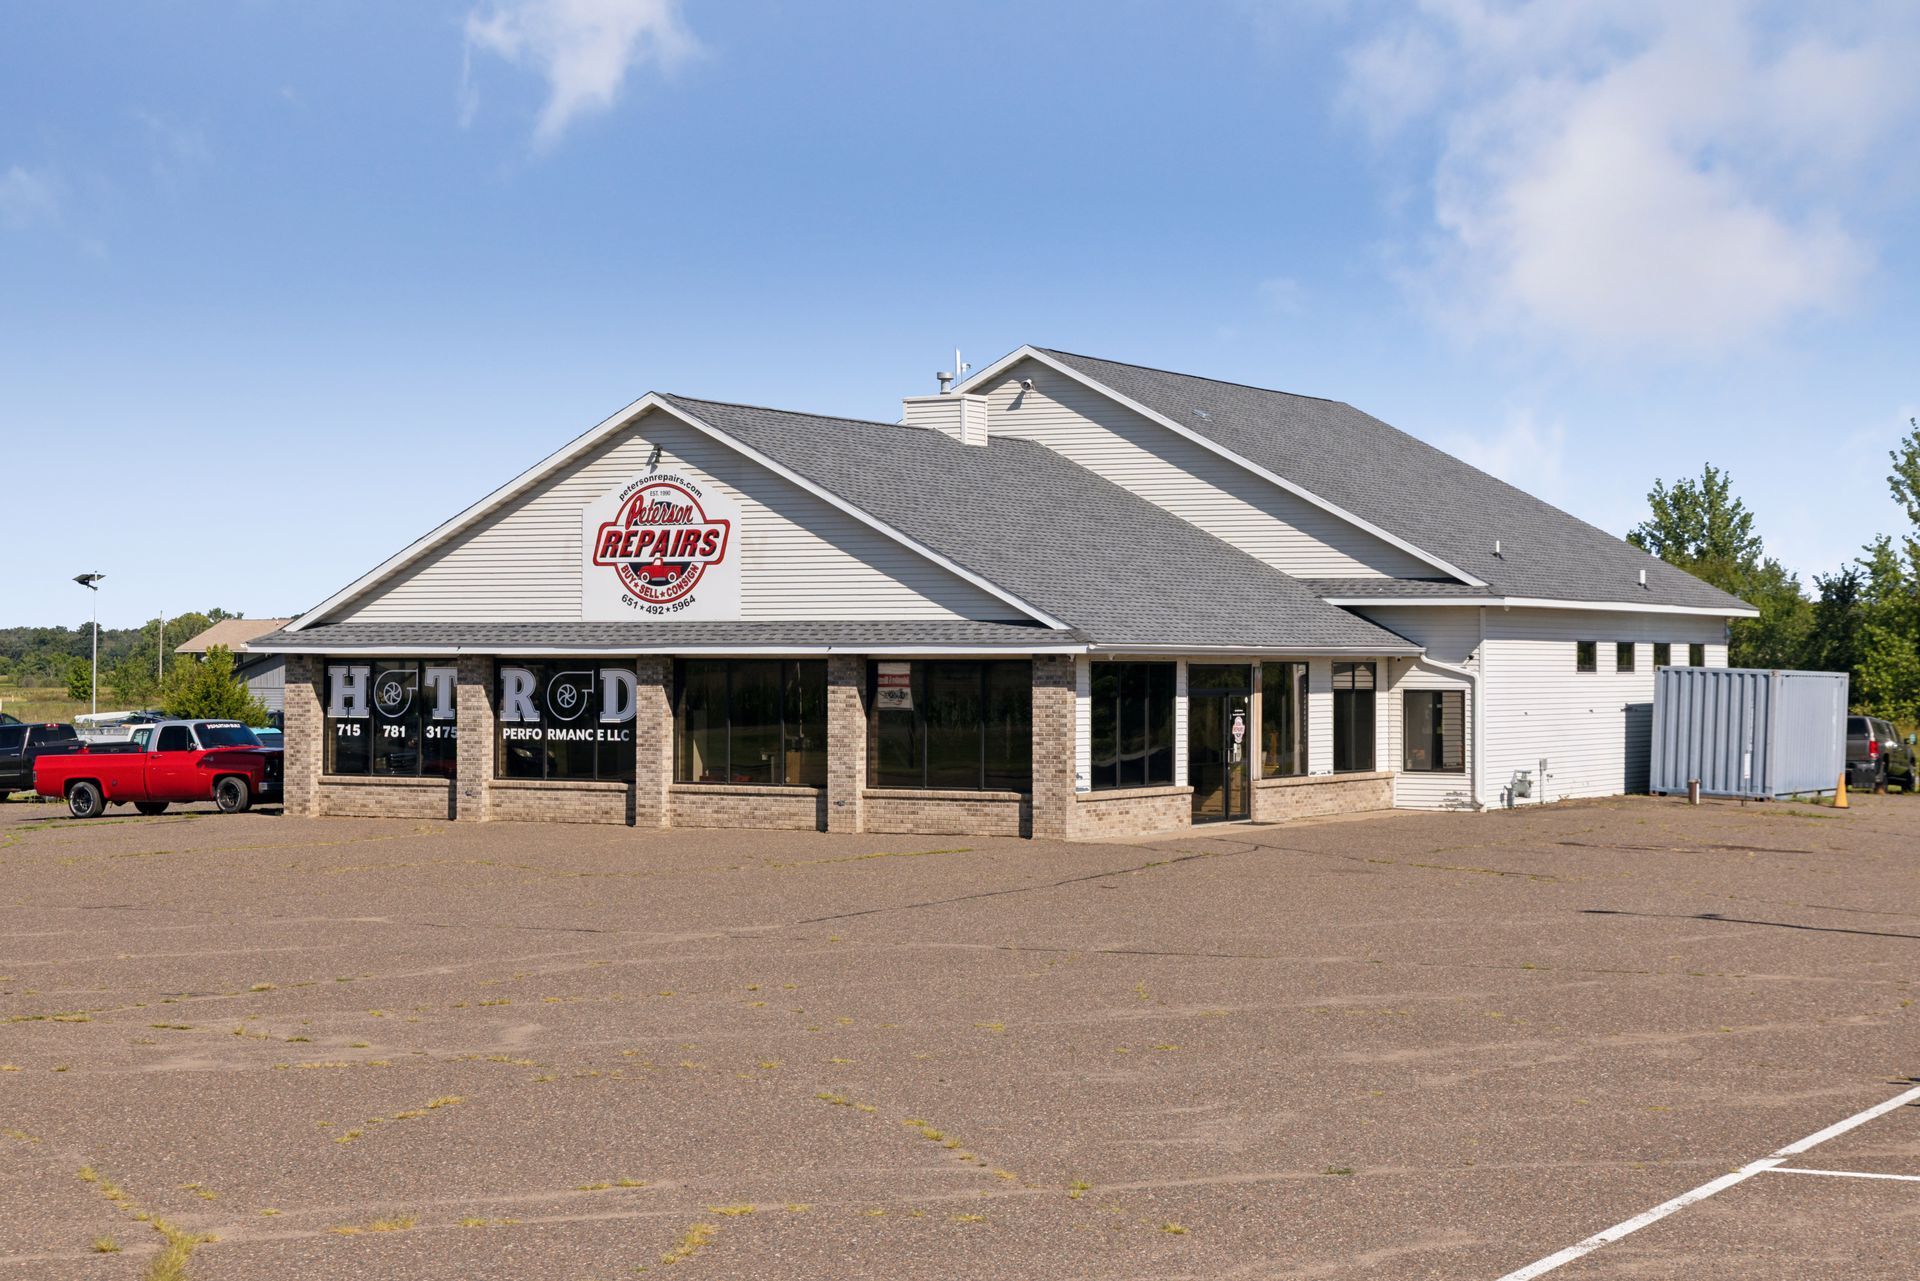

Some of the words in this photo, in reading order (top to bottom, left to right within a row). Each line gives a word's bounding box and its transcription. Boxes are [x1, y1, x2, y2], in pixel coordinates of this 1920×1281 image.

[618, 474, 703, 501] petersonrepairs.com
[625, 494, 694, 530] Peterson
[600, 529, 720, 558] REPAIRS
[621, 564, 637, 584] BUY
[639, 584, 660, 599] SELL
[666, 564, 700, 597] CONSIGN
[621, 594, 638, 609] 651
[646, 605, 664, 615] 492
[672, 594, 696, 612] 5964
[336, 724, 361, 737] 715
[382, 725, 406, 738] 781
[426, 725, 457, 738] 3175
[607, 729, 630, 741] LLC
